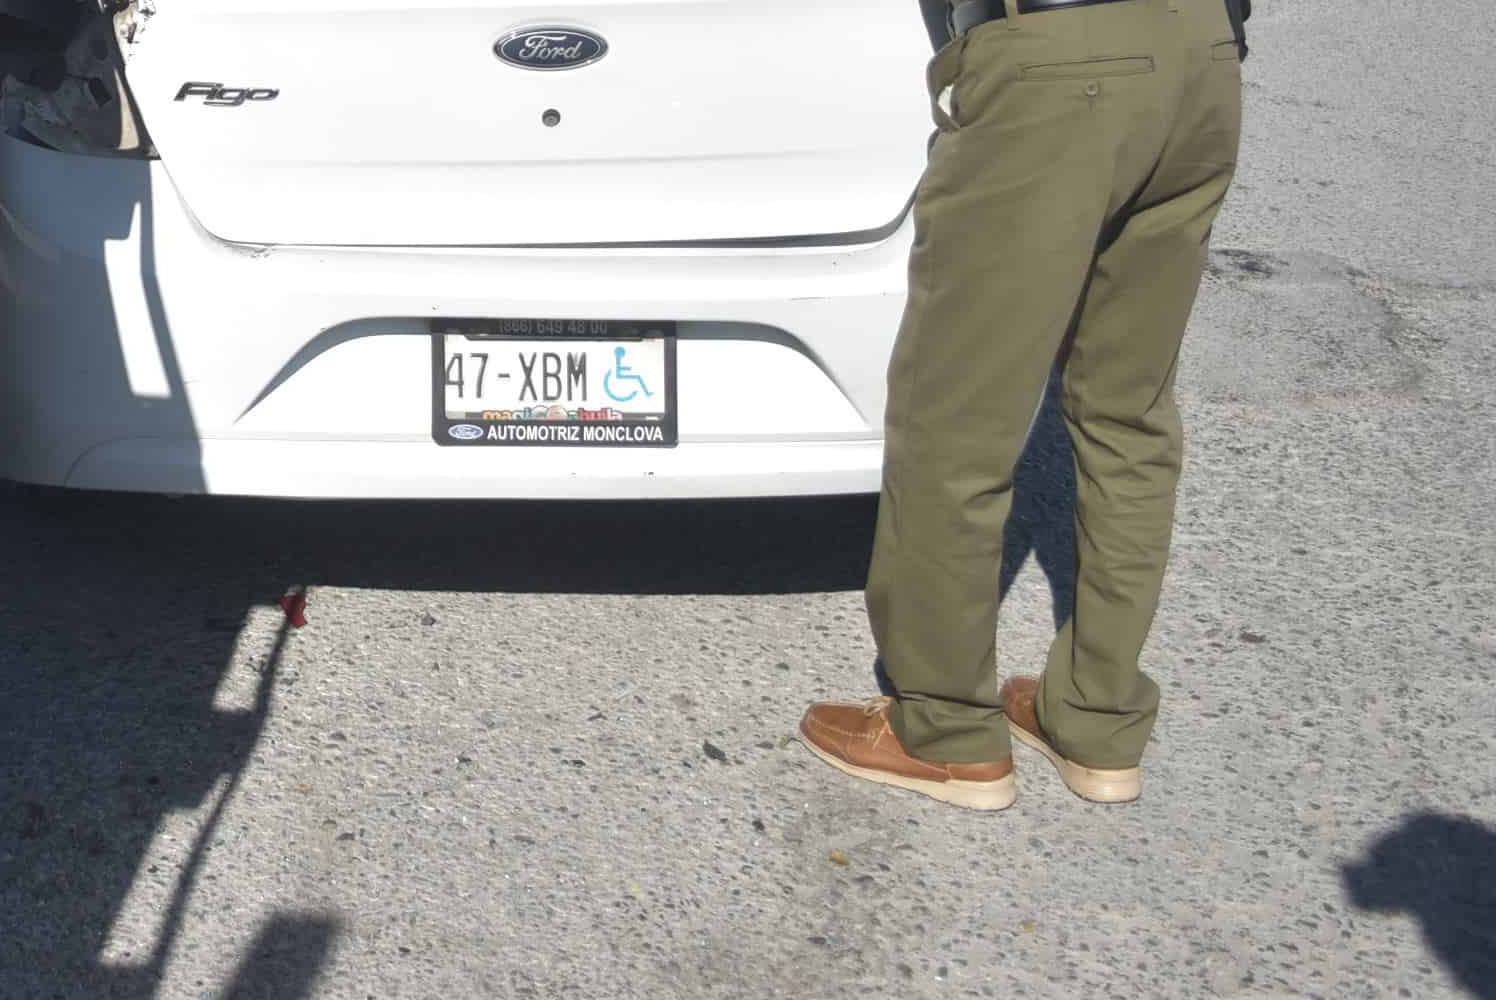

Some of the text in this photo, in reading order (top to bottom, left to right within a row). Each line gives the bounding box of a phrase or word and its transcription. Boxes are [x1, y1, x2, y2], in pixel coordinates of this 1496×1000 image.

[517, 33, 583, 61] Ford
[173, 81, 280, 107] Figo
[487, 425, 663, 442] AUTOMOTRIZ MONCLOVA
